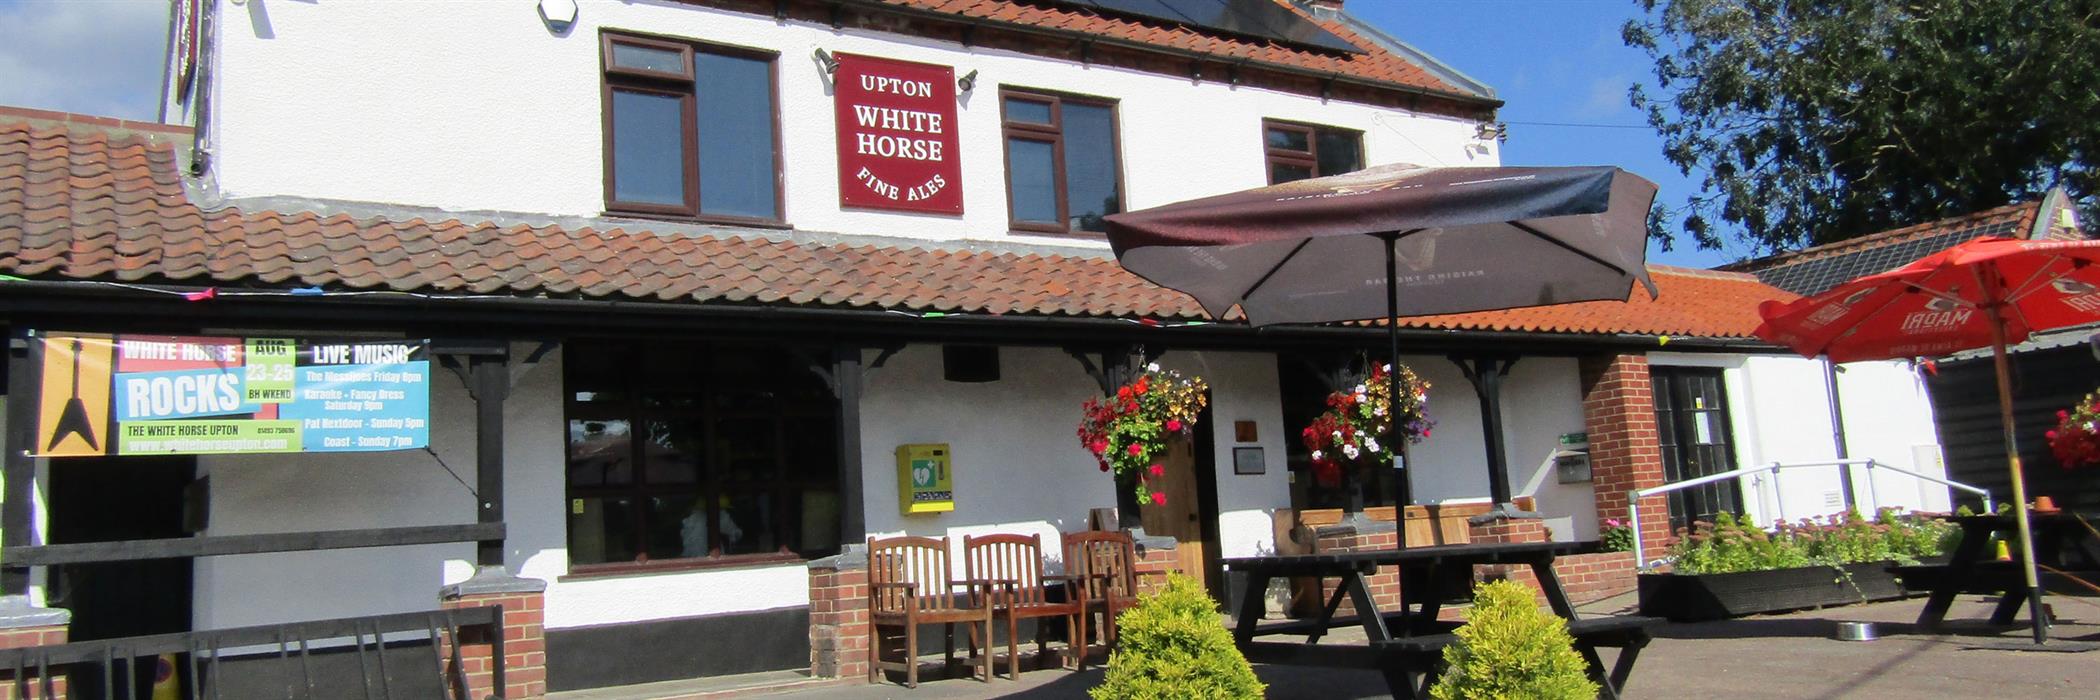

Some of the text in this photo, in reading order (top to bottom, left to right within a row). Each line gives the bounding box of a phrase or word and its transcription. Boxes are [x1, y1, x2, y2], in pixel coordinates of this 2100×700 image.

[860, 74, 931, 98] UPTON
[853, 104, 942, 134] WHITE
[856, 133, 942, 161] HORSE
[856, 166, 946, 201] FINE ALES
[124, 340, 236, 361] WHITE HORSE
[255, 340, 287, 355] AUG
[313, 344, 408, 364] LIVE MUSIC
[246, 364, 293, 381] 23-25
[306, 371, 323, 381] The
[374, 372, 401, 383] Friday
[127, 373, 240, 417] ROCKS
[248, 389, 291, 399] BH WKEND
[304, 389, 342, 399] Karaoke
[351, 389, 377, 400] Fancy
[379, 389, 405, 399] Dress
[324, 401, 362, 411] Saturday
[128, 425, 238, 436] THE WHITE HORSE UPTON
[304, 418, 320, 428] Pat
[370, 418, 404, 429] Sunday
[324, 437, 350, 447] Coast
[358, 436, 391, 447] Sunday
[392, 436, 412, 447] 7pm
